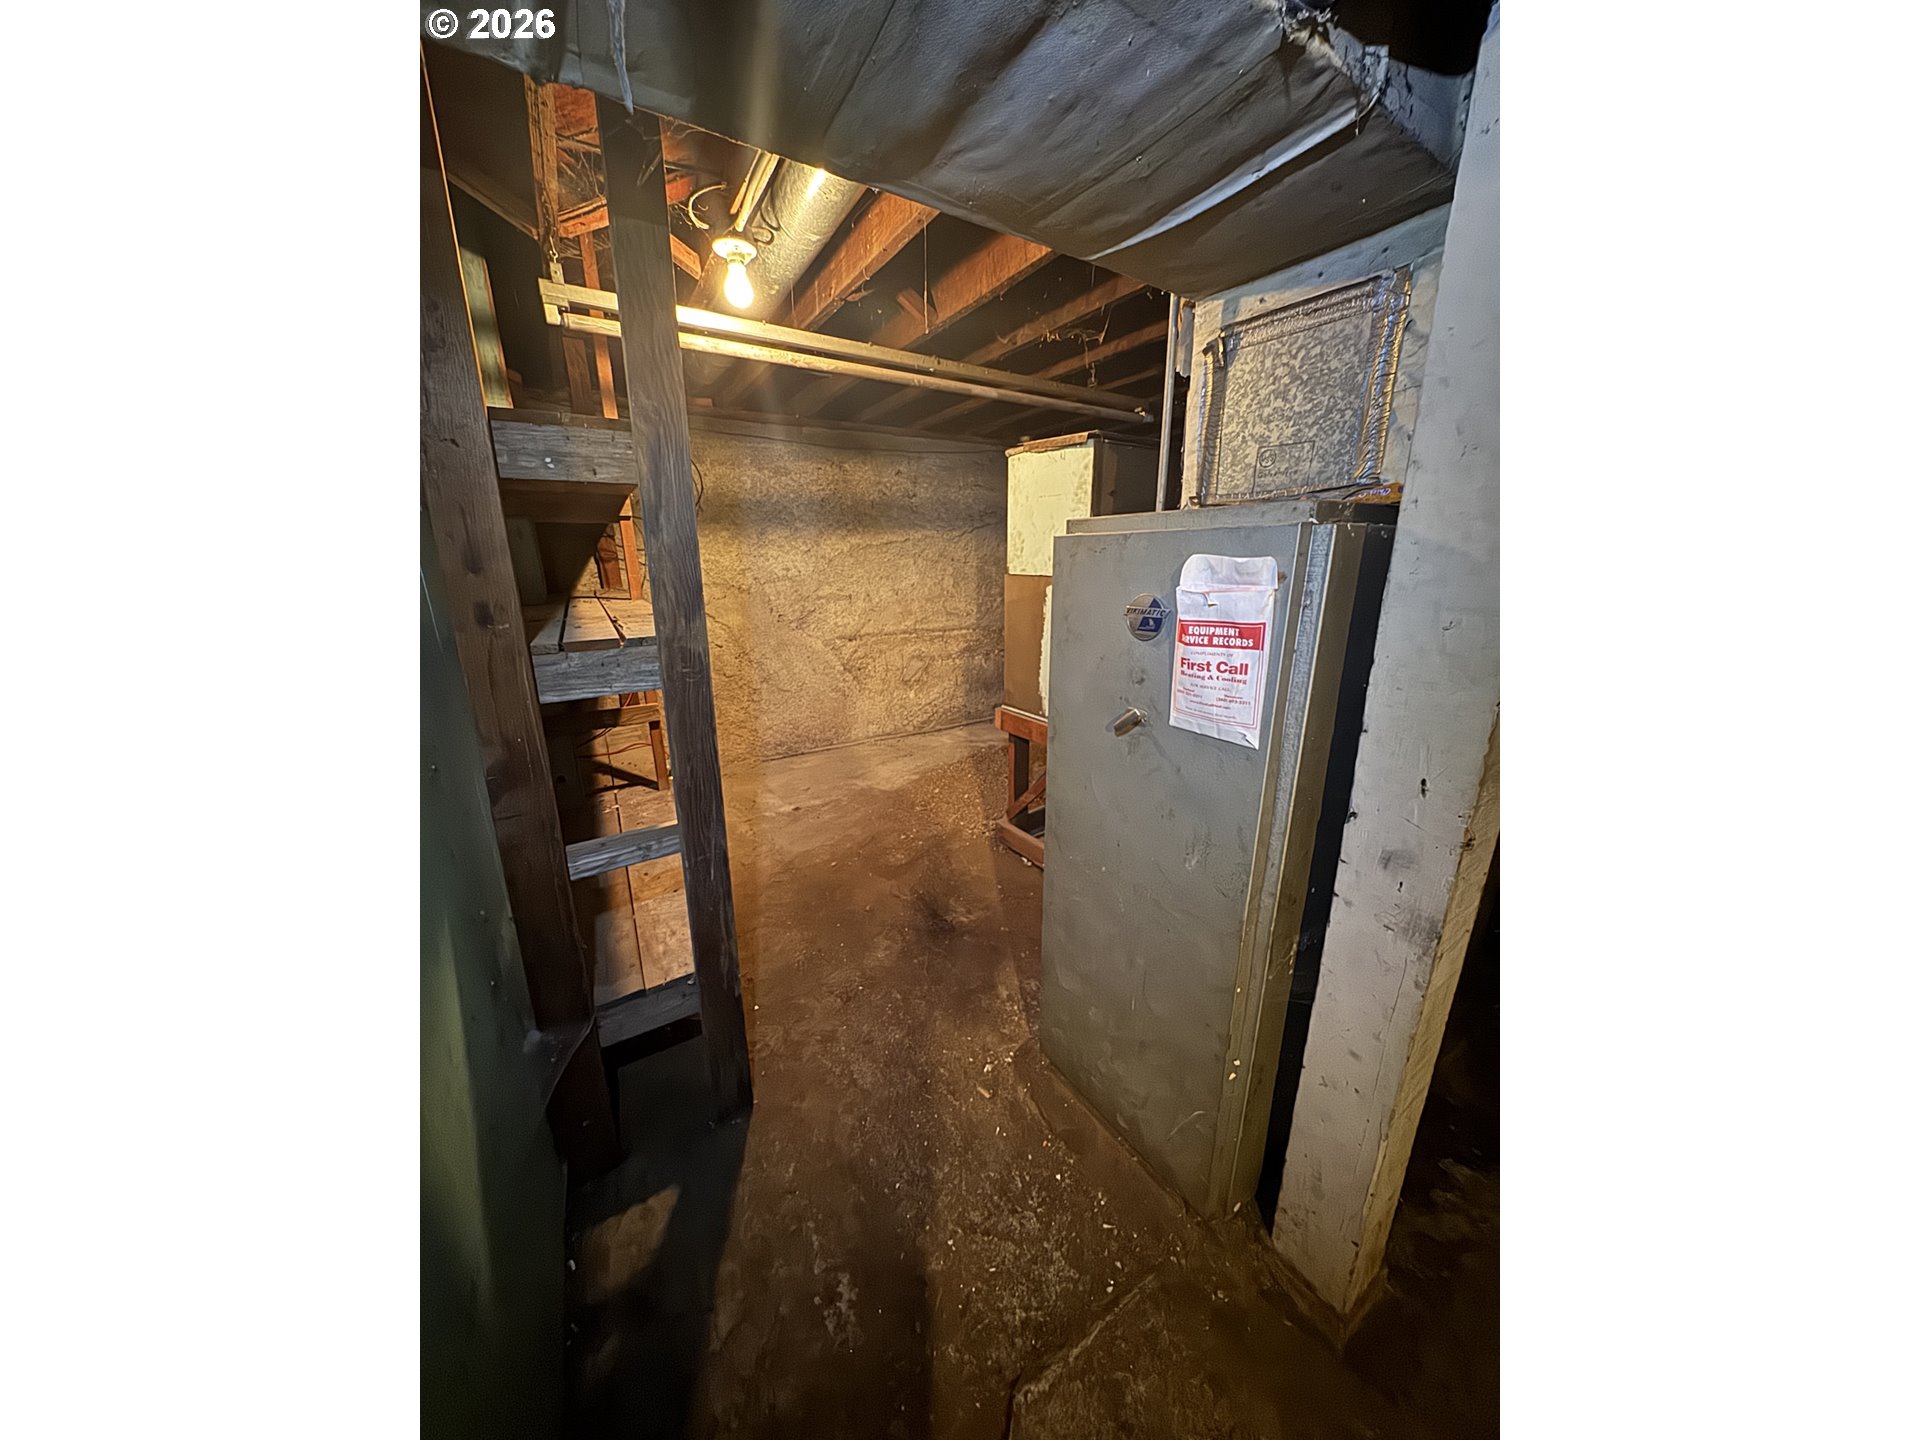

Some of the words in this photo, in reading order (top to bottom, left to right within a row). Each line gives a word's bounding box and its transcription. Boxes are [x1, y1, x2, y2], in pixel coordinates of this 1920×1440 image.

[1188, 625, 1240, 637] EQUIPMENT
[1181, 633, 1209, 645] RVICE
[1212, 635, 1254, 647] RECORDS
[1180, 657, 1212, 673] First
[1216, 661, 1249, 676] Call
[1180, 670, 1206, 681] Heating
[1216, 675, 1248, 685] Cooling
